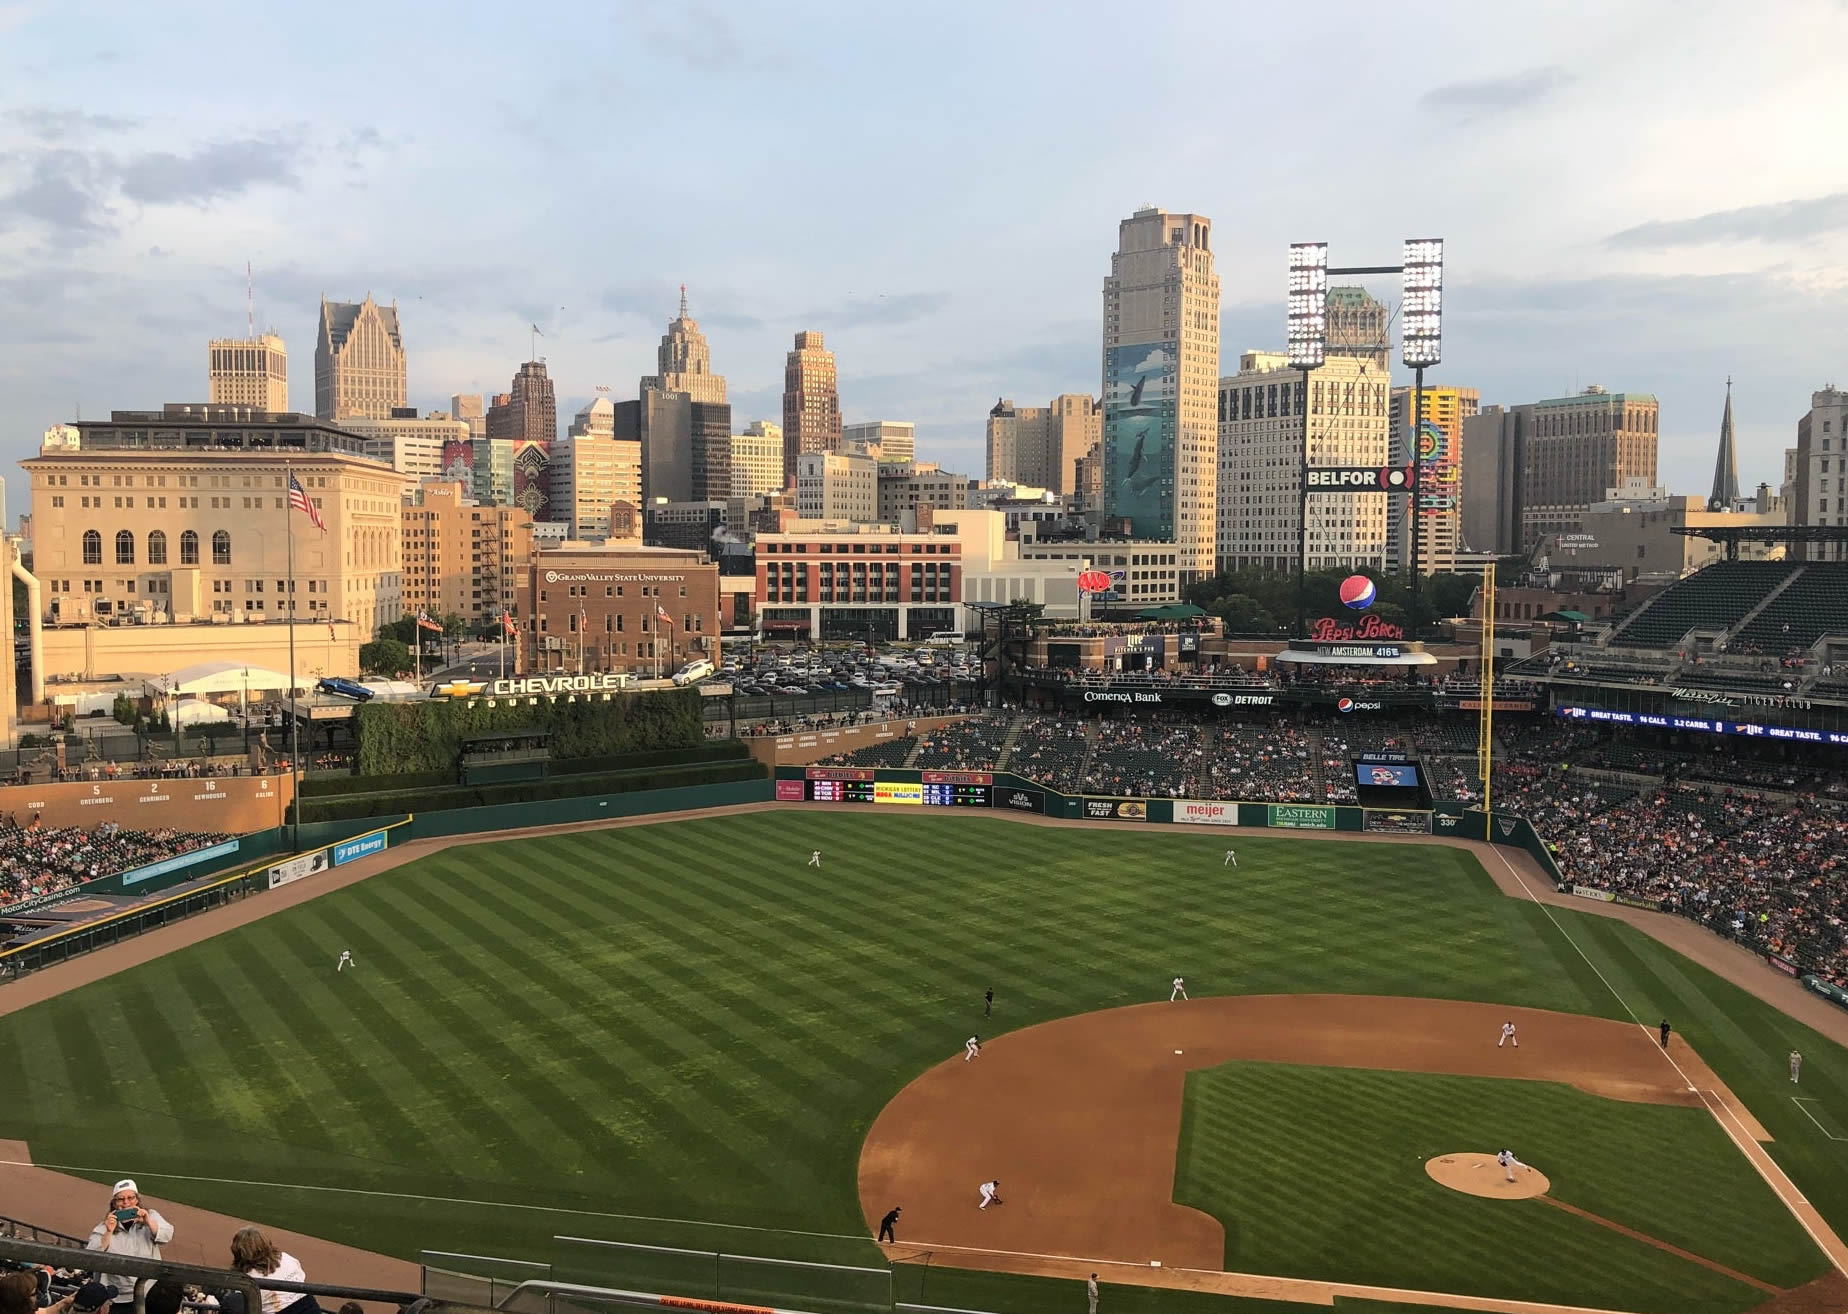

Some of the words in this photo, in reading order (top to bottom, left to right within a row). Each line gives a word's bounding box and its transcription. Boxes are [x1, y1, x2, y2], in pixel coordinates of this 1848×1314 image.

[1308, 471, 1376, 486] BELFOR
[558, 574, 586, 582] GRAND
[586, 574, 614, 582] VALLEY
[615, 574, 638, 582] STATE
[638, 574, 686, 582] UNIVERSITY
[1317, 646, 1331, 657] NEW
[1332, 646, 1372, 657] AMSTERDAM
[494, 674, 630, 695] CHEVROLET
[467, 693, 612, 709] FOUNTAIN
[1135, 692, 1162, 702] Bank
[1235, 696, 1274, 704] DETROIT
[1744, 696, 1774, 706] TIGER
[1786, 700, 1811, 709] CLUB
[1354, 702, 1380, 711] pepsi
[1572, 708, 1586, 717] Lite
[1591, 711, 1610, 719] GREAT
[1611, 713, 1633, 722] TASTE.
[1649, 717, 1667, 725] CALS.
[1685, 720, 1710, 729] CARBS.
[1747, 724, 1763, 735] Lite
[1770, 729, 1794, 737] GREAT
[1796, 731, 1822, 740] TASTE.
[94, 785, 100, 795] 5
[152, 783, 158, 793] 2
[206, 781, 215, 791] 16
[262, 780, 267, 789] 6
[1008, 799, 1033, 807] VISION
[1186, 804, 1224, 817] meijer
[1277, 807, 1327, 818] EASTERN
[347, 845, 360, 856] DTE
[361, 839, 382, 851] Energy
[1, 886, 80, 915] MotorCityCasino.com
